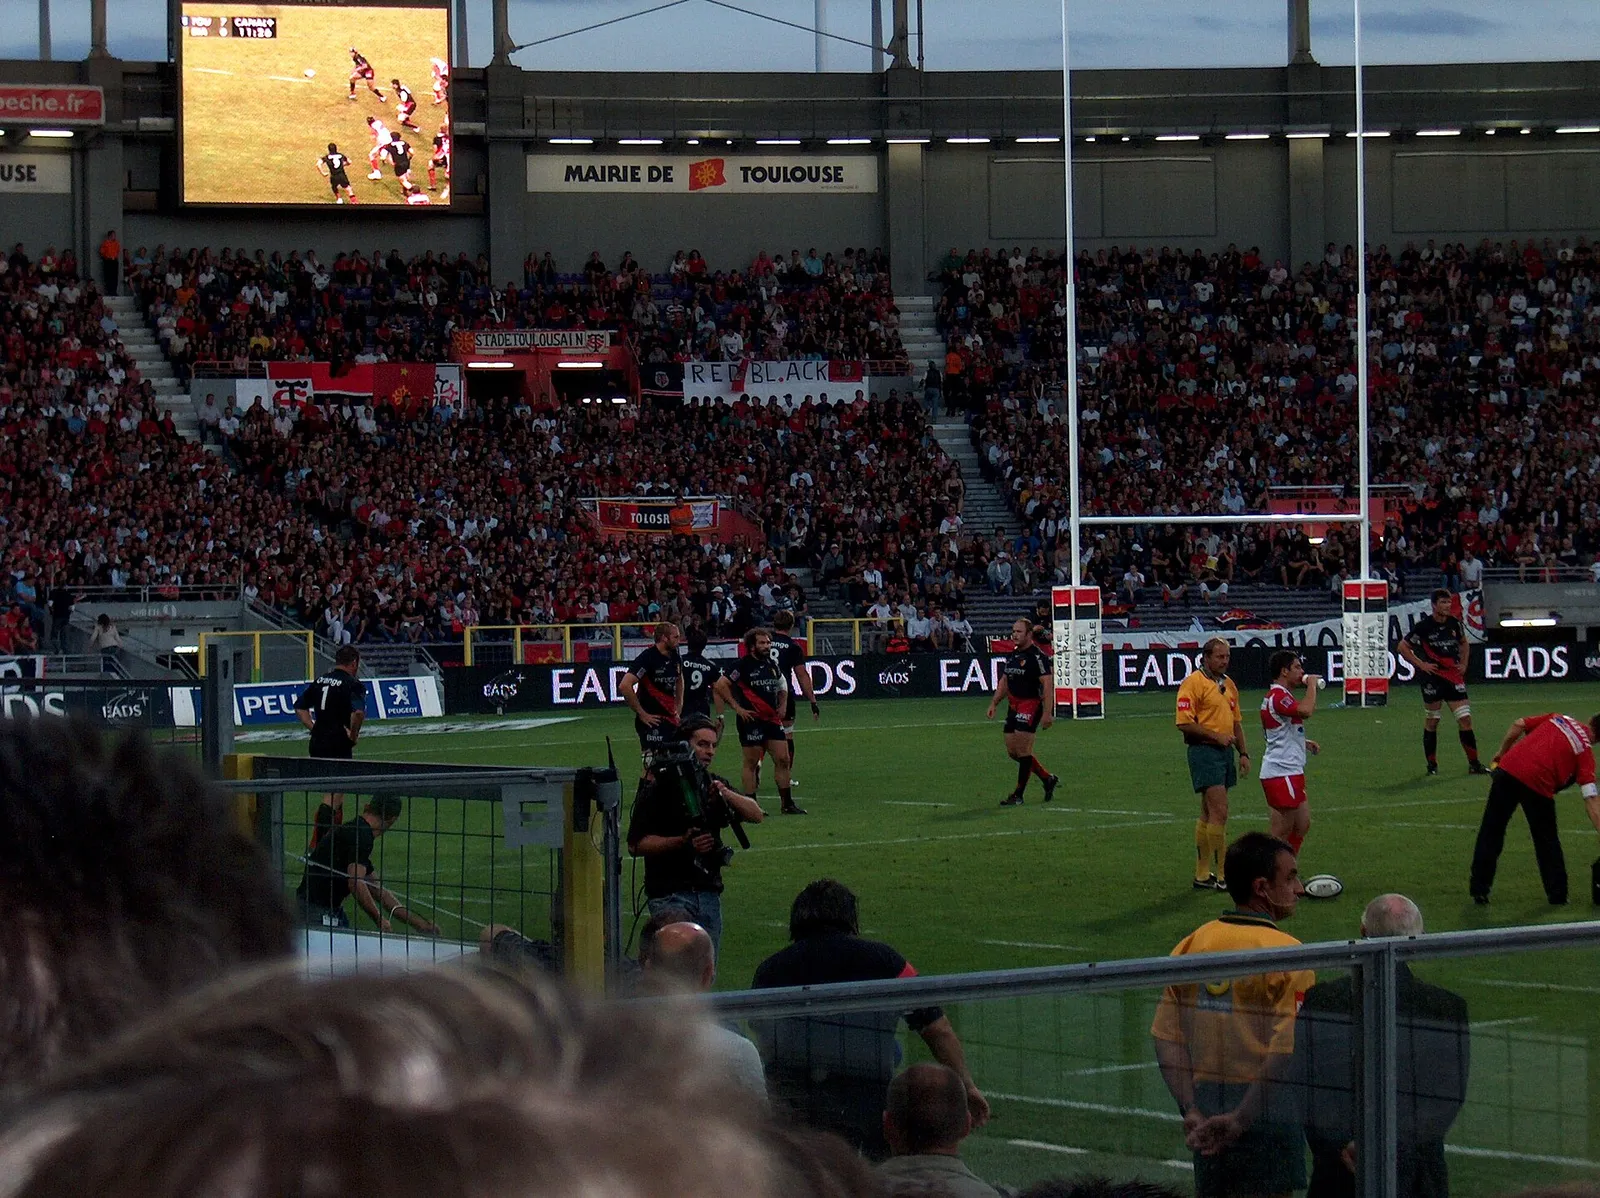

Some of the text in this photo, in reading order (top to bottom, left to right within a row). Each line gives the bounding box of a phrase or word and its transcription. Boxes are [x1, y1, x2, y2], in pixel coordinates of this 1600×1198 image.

[564, 165, 844, 183] MAIRIE DE TOULOUSE
[1089, 621, 1098, 686] GENERALE
[1484, 646, 1569, 680] EADS
[683, 660, 711, 671] Orange
[316, 676, 342, 687] Orange
[552, 666, 638, 703] EAD
[690, 670, 703, 690] 9
[878, 672, 910, 685] EADS
[320, 686, 329, 710] 1
[102, 704, 142, 719] EADS
